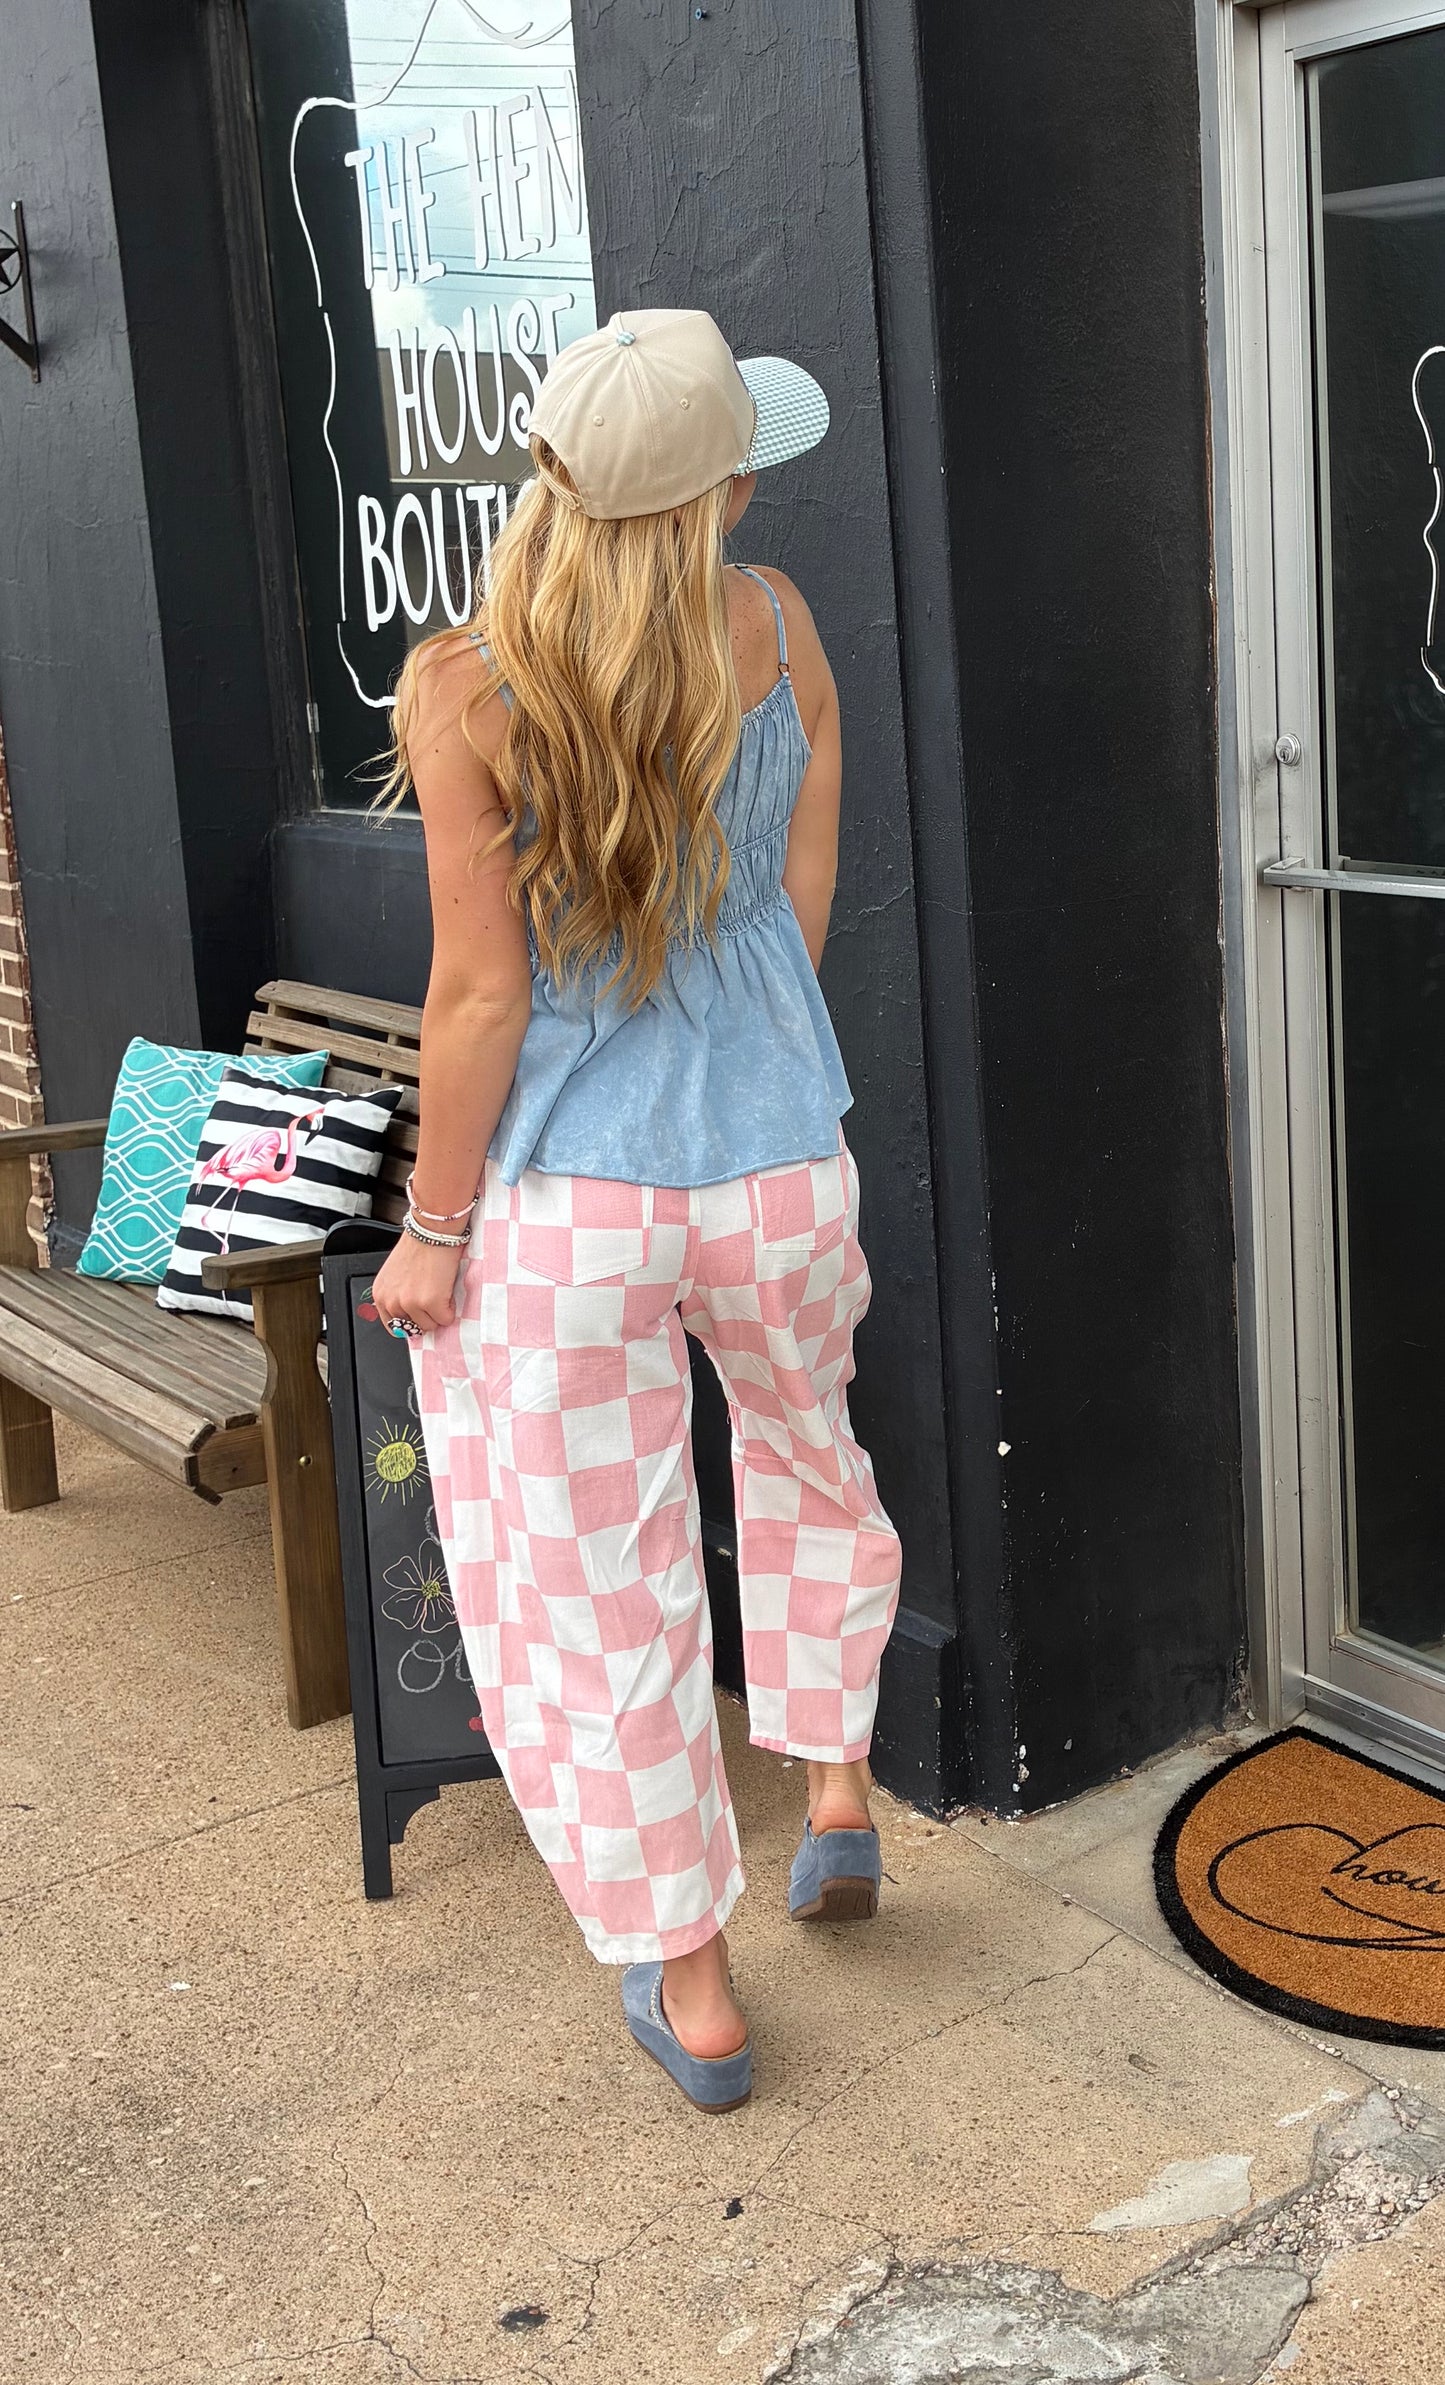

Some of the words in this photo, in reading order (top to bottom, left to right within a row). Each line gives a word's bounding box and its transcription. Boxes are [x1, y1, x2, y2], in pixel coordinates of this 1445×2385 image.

[344, 127, 446, 292] THE
[462, 69, 584, 270] HEN
[358, 479, 541, 633] BOUT
